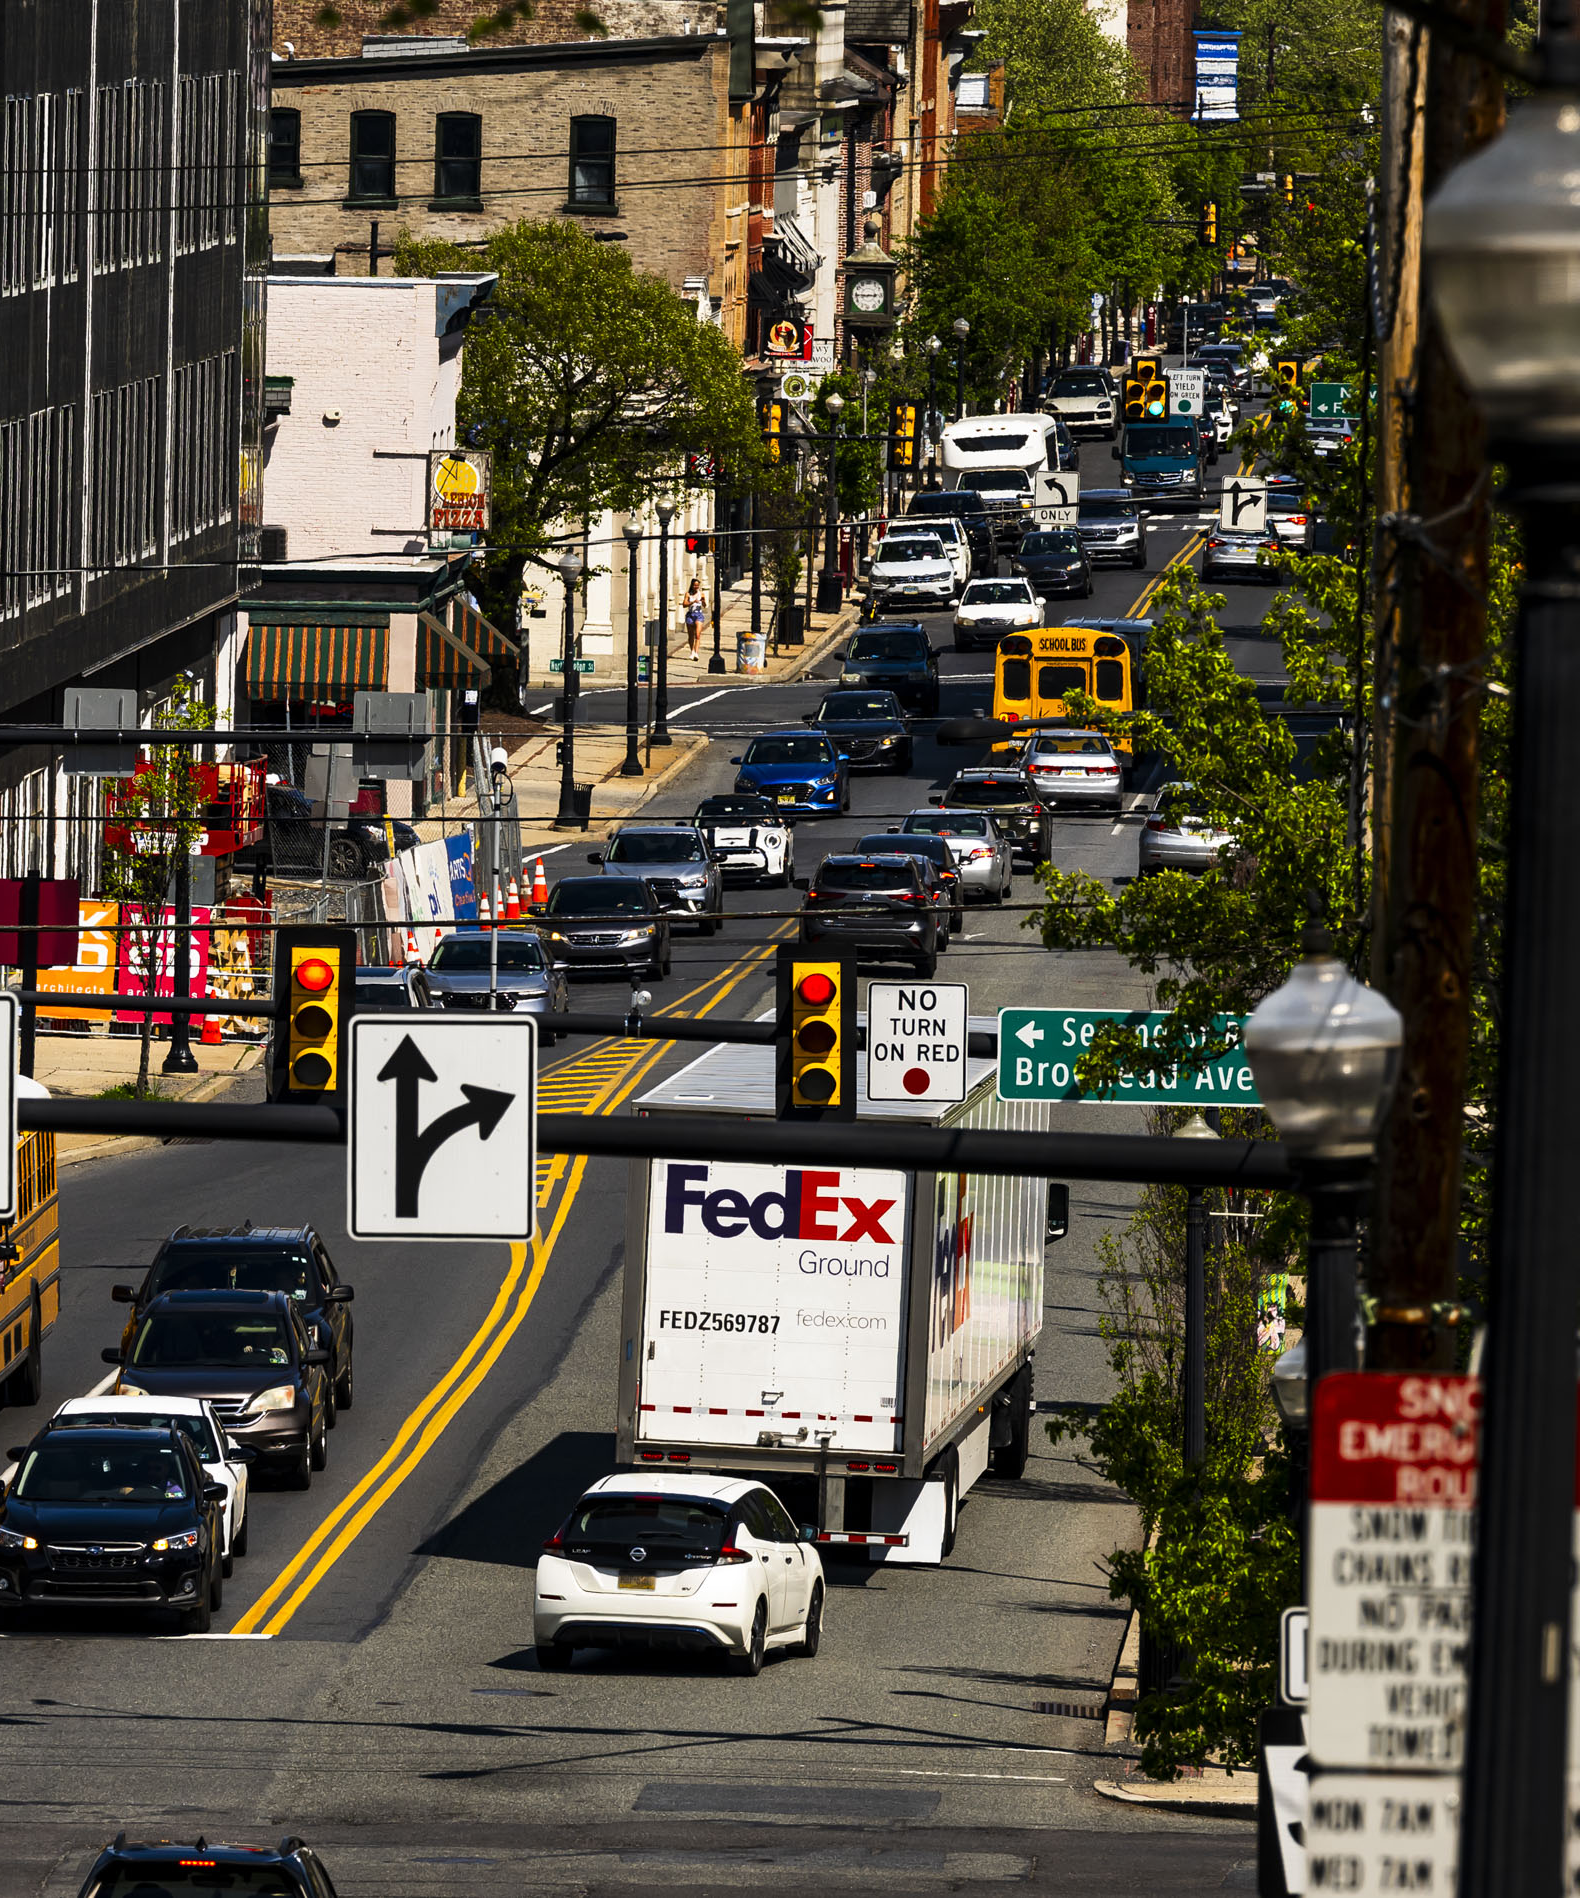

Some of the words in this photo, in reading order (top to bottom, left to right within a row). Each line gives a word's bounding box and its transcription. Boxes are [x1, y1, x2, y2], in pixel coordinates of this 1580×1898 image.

[1175, 383, 1196, 391] YIELD
[442, 491, 485, 509] LEHIGH
[433, 508, 485, 530] PIZZA
[1040, 509, 1071, 521] ONLY
[1039, 637, 1069, 651] SCHOOL
[1071, 638, 1087, 651] BUS
[898, 989, 937, 1011] NO
[890, 1018, 946, 1036] TURN
[874, 1043, 904, 1061] ON
[917, 1044, 960, 1062] RED
[1195, 1064, 1253, 1091] Ave
[664, 1163, 897, 1244] FedEx
[798, 1249, 890, 1278] Ground
[659, 1310, 781, 1334] FEDZ569787
[796, 1309, 887, 1330] fedex.com
[1350, 1509, 1427, 1543] SNOW
[1332, 1549, 1434, 1586] CHAINS
[1358, 1593, 1406, 1630] NO
[1318, 1638, 1417, 1675] DURING
